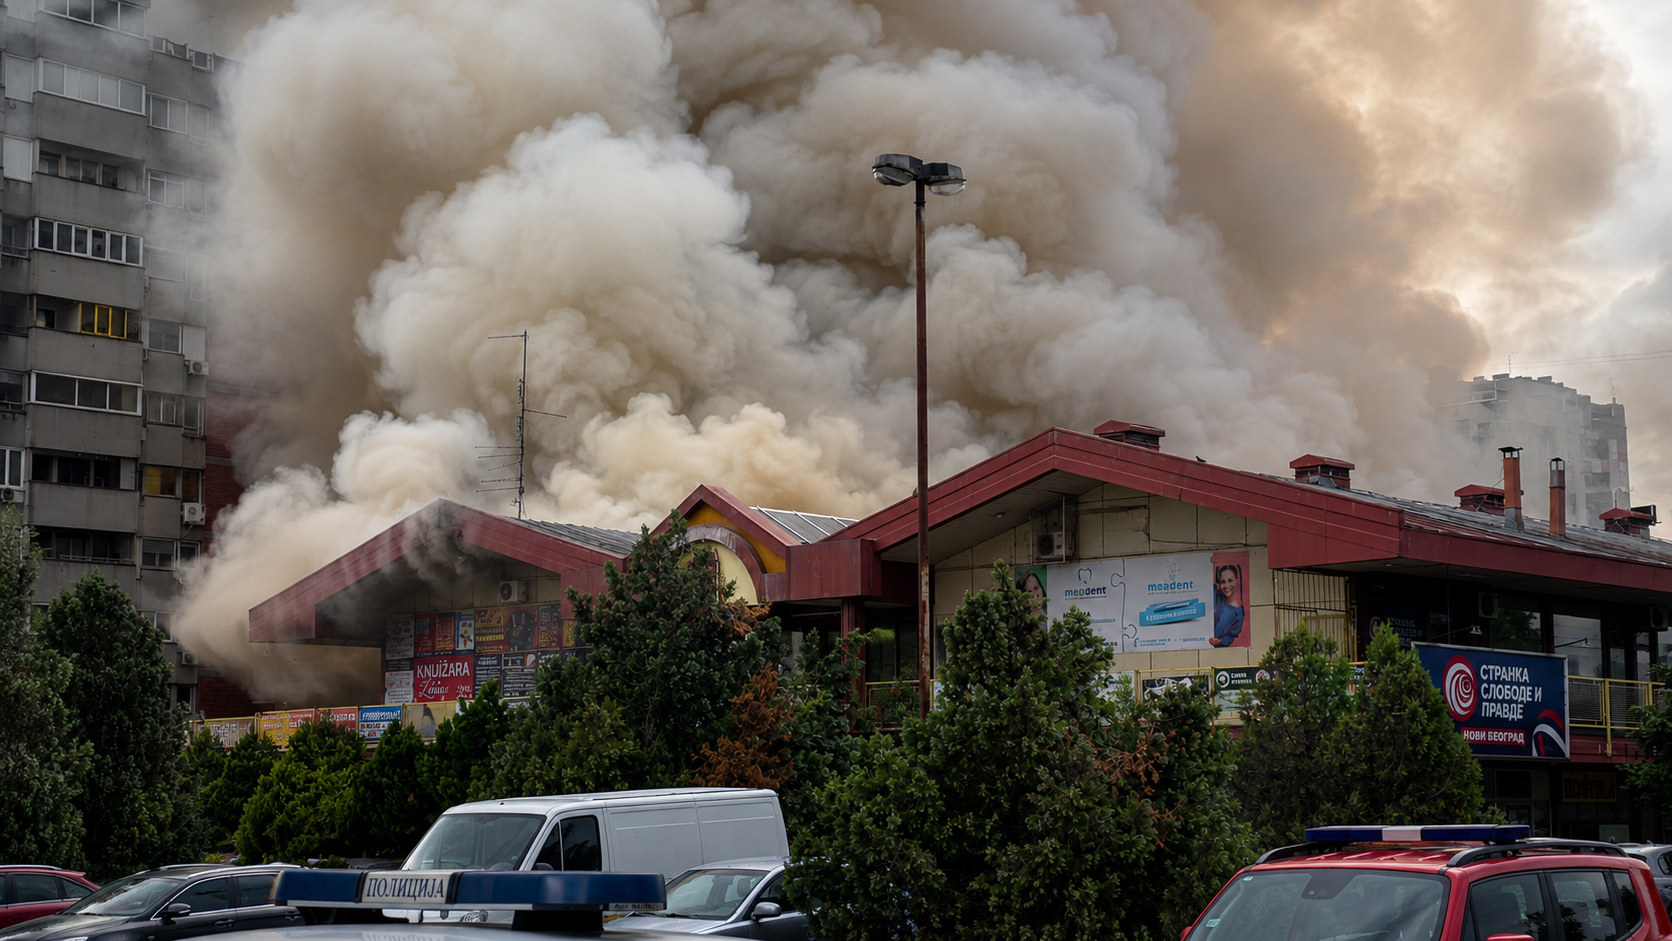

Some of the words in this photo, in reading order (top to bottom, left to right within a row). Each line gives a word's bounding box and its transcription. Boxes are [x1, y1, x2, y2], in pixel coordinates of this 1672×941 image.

[1480, 664, 1530, 683] СТРАНКА
[1480, 683, 1533, 704] СЛОБОДЕ
[1534, 686, 1542, 702] И
[1481, 701, 1524, 721] ПРАВДЕ
[1463, 730, 1486, 741] НОВИ
[1487, 731, 1525, 744] БЕОГРАД
[366, 878, 445, 901] ПОЛИЦИЈА
